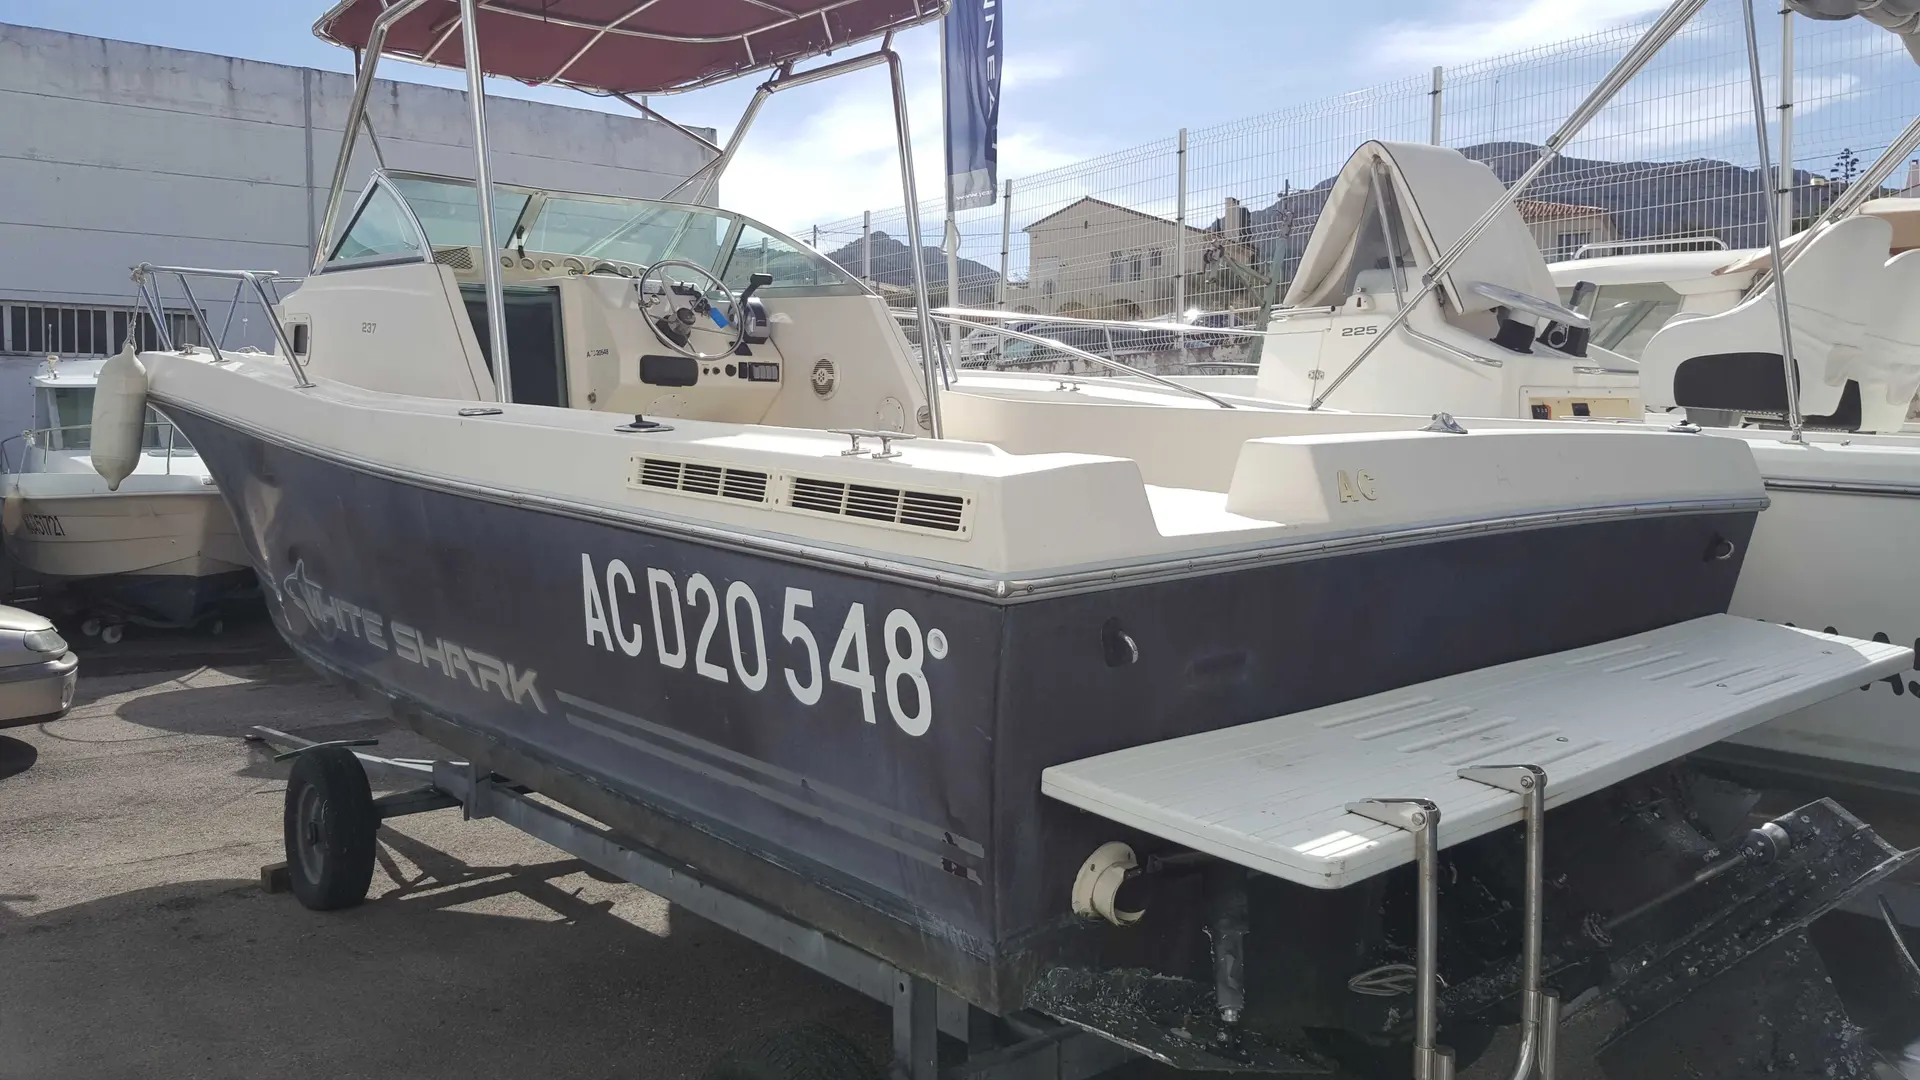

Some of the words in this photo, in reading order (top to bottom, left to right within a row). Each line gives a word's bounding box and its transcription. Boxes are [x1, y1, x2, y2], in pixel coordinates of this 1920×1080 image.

[361, 321, 377, 334] 237
[1341, 325, 1378, 337] 225
[1336, 468, 1377, 503] AC
[298, 582, 389, 651] WHITE
[390, 620, 548, 715] SHARK
